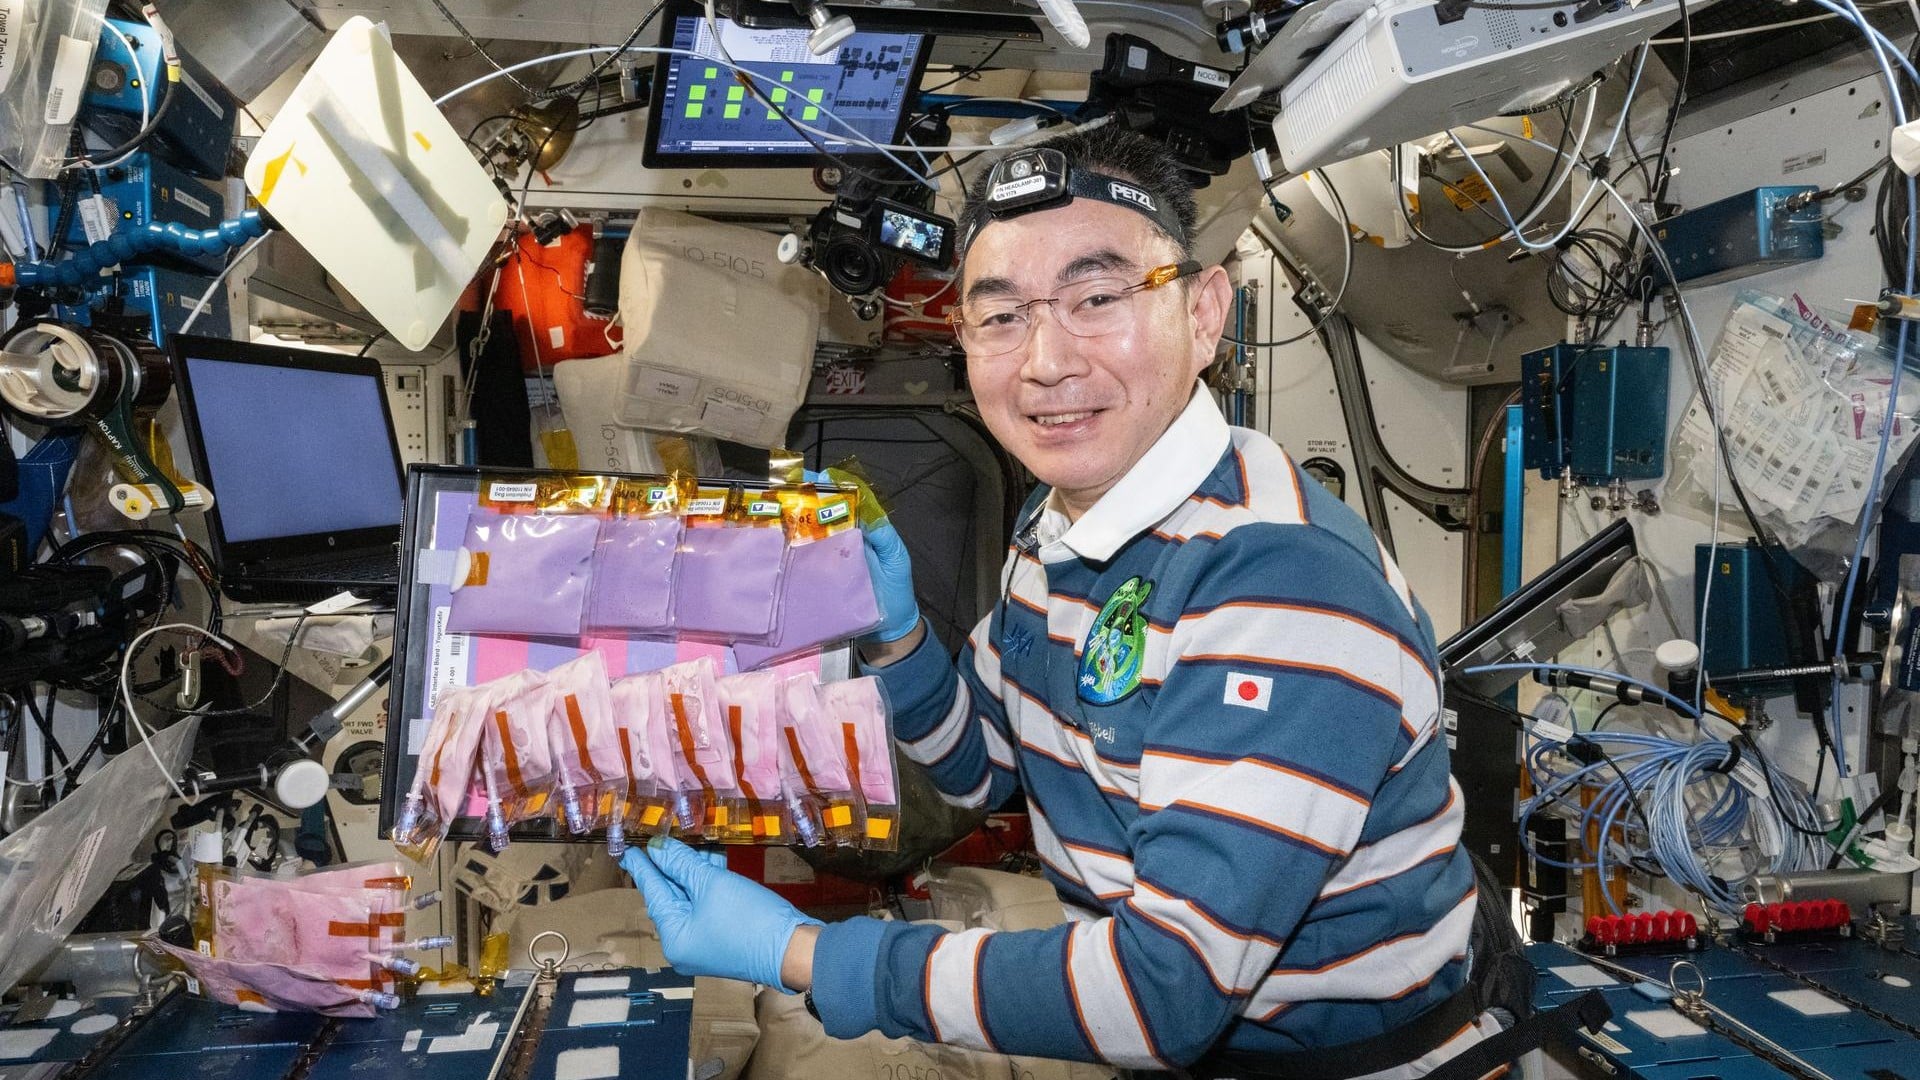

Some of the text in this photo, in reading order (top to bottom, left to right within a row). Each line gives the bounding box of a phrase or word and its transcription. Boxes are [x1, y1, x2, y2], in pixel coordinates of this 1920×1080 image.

[1110, 182, 1158, 212] PETZL
[832, 371, 861, 388] EXIT
[97, 420, 123, 450] KAPTON
